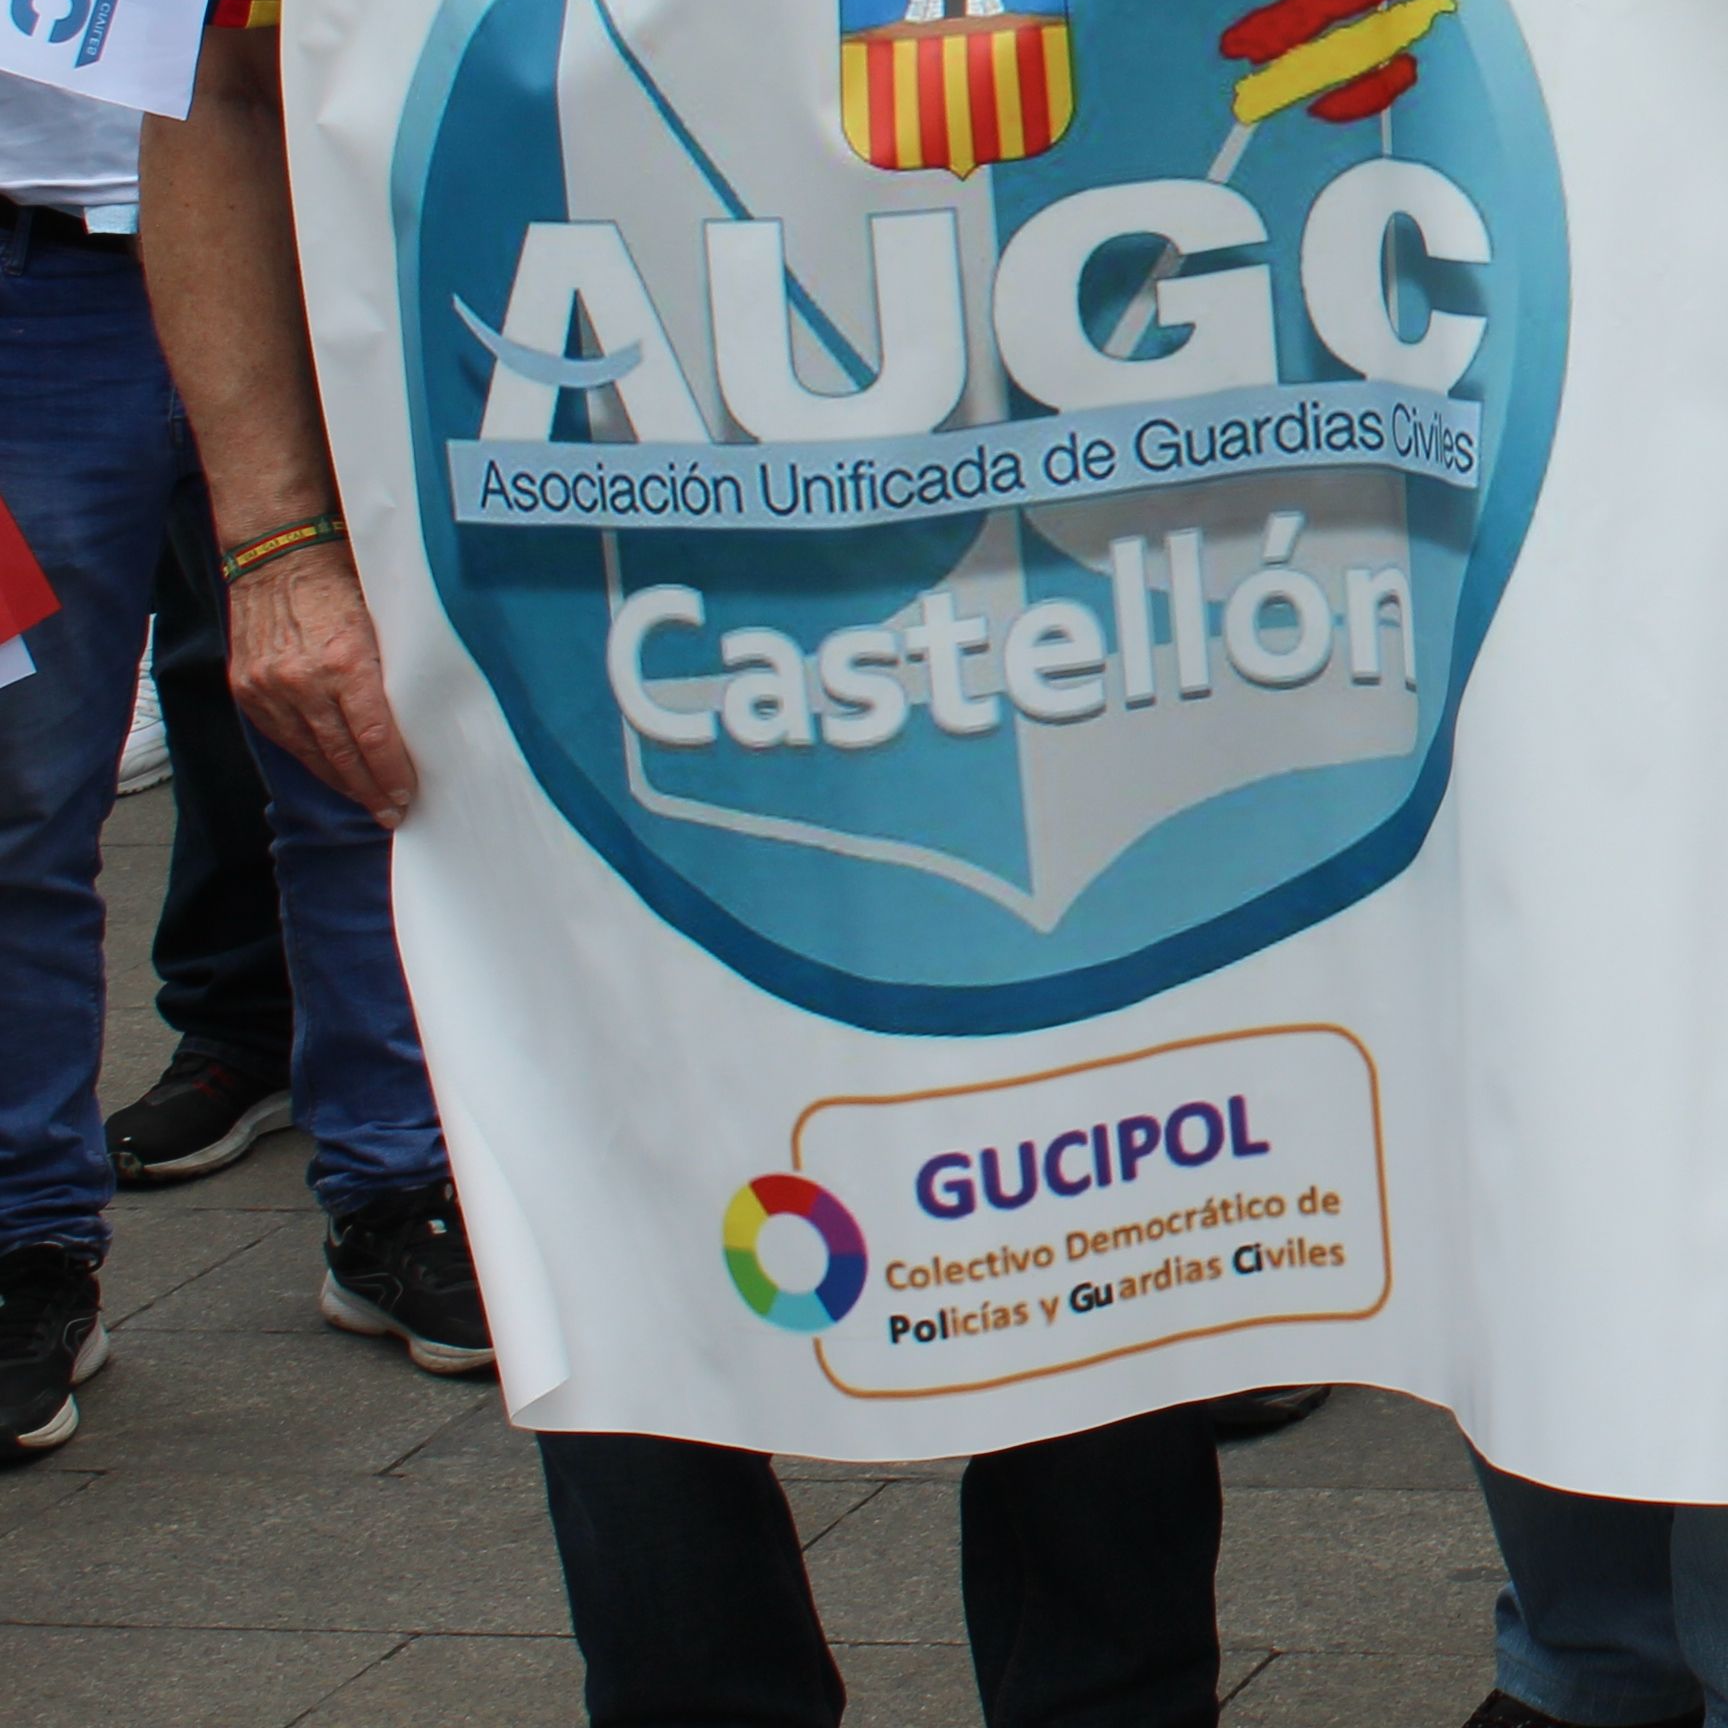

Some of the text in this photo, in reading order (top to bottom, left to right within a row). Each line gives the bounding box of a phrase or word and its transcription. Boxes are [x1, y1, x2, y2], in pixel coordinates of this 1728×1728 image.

[470, 157, 1494, 444] AUGC
[478, 402, 1477, 518] Asociación Unificada de Guardias Civiles
[605, 513, 1418, 750] Castellón
[915, 1093, 1270, 1222] GUCIPOL
[884, 1185, 1342, 1292] Colectivo Democrático de
[890, 1240, 1346, 1346] Policías y Guardias Civiles
